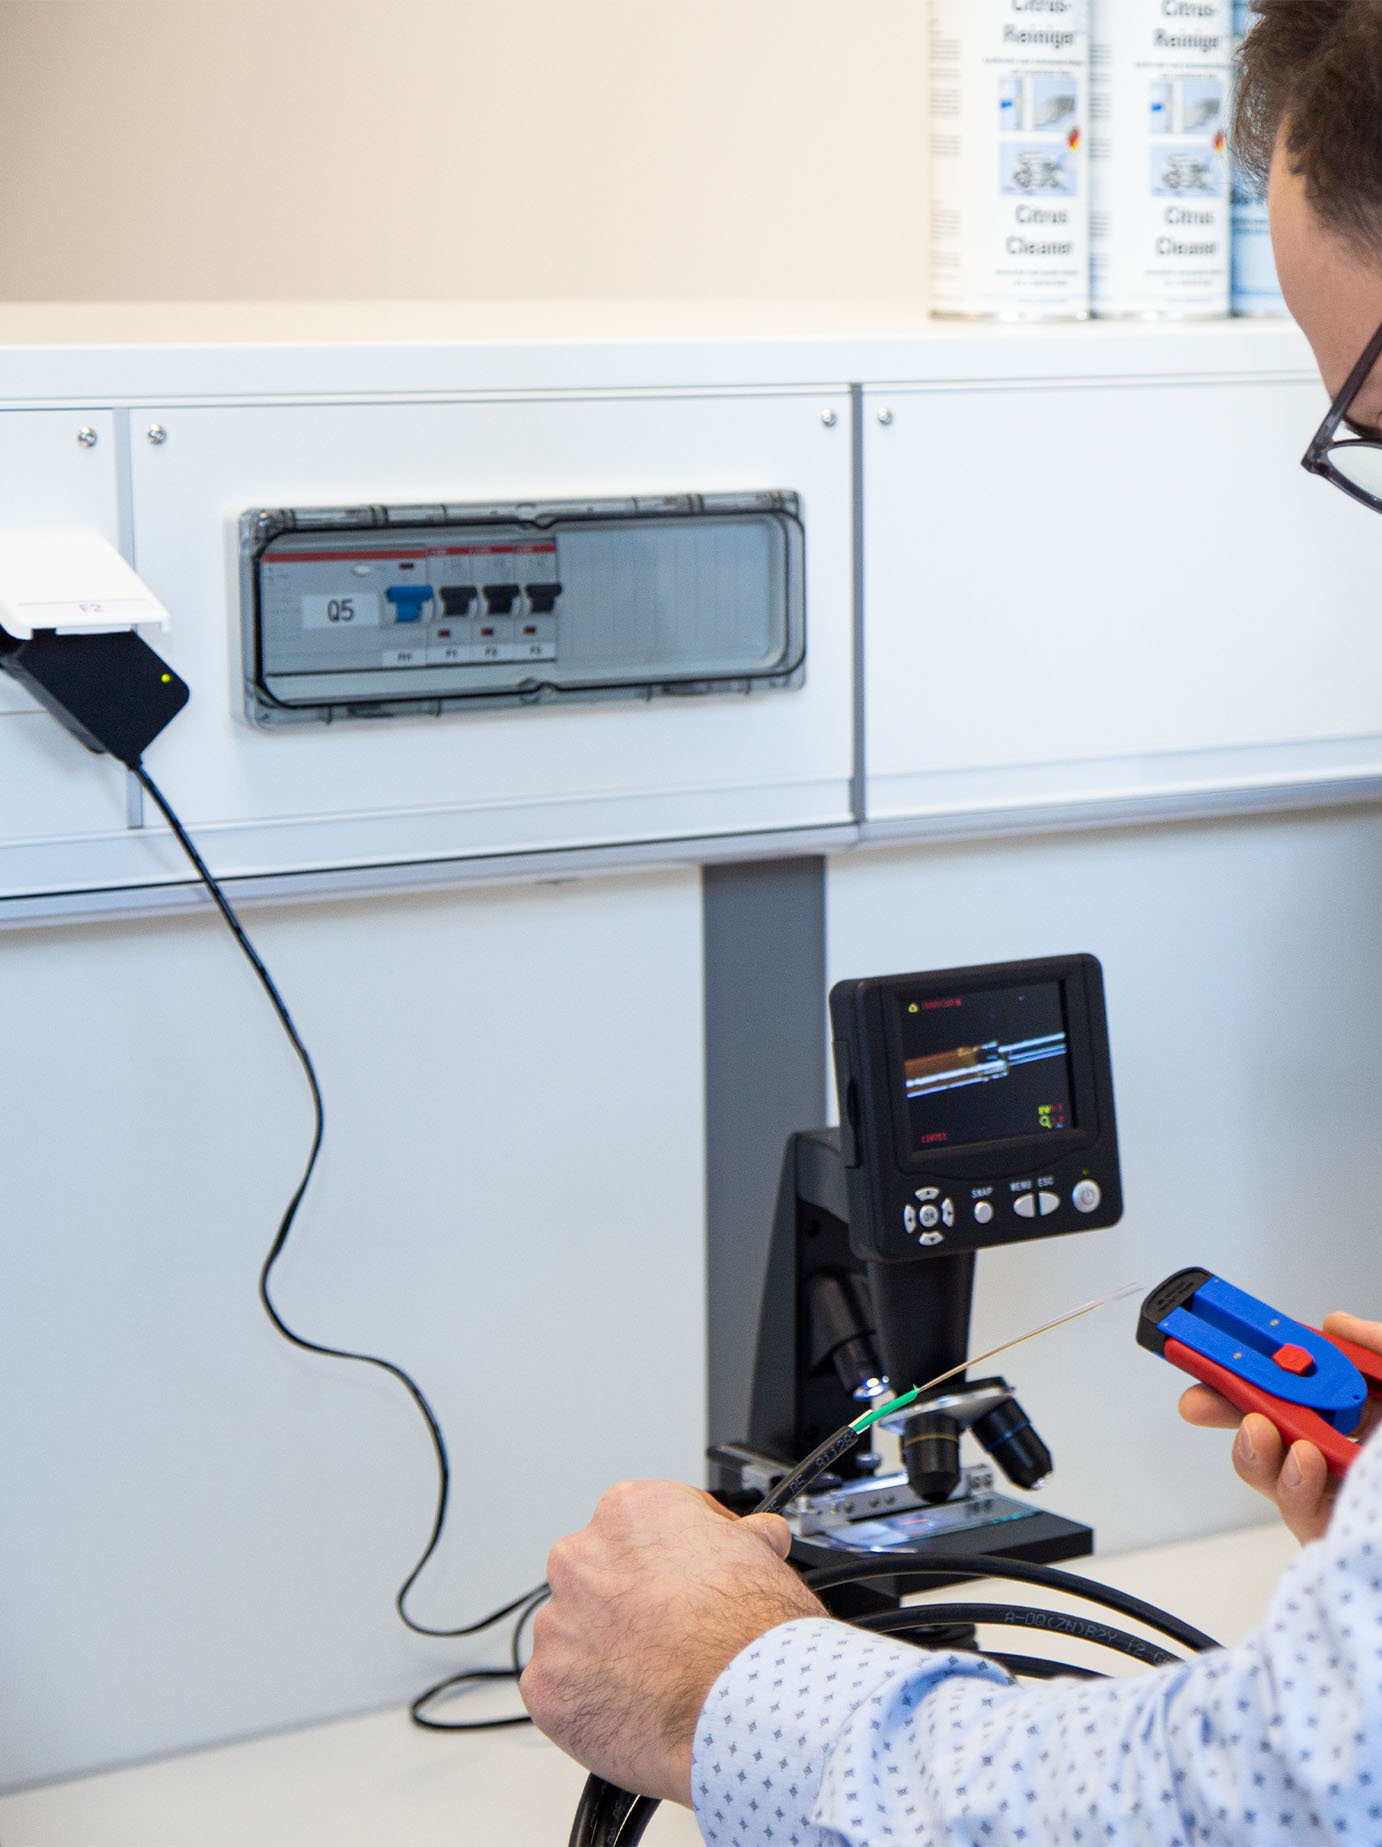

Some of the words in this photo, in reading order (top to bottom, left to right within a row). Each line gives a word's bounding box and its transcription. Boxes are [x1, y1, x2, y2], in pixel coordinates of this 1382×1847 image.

[326, 598, 355, 623] Q5
[1010, 1180, 1033, 1192] MENU
[1037, 1176, 1054, 1188] ESC
[971, 1187, 994, 1199] SNAP
[923, 1211, 935, 1223] OK
